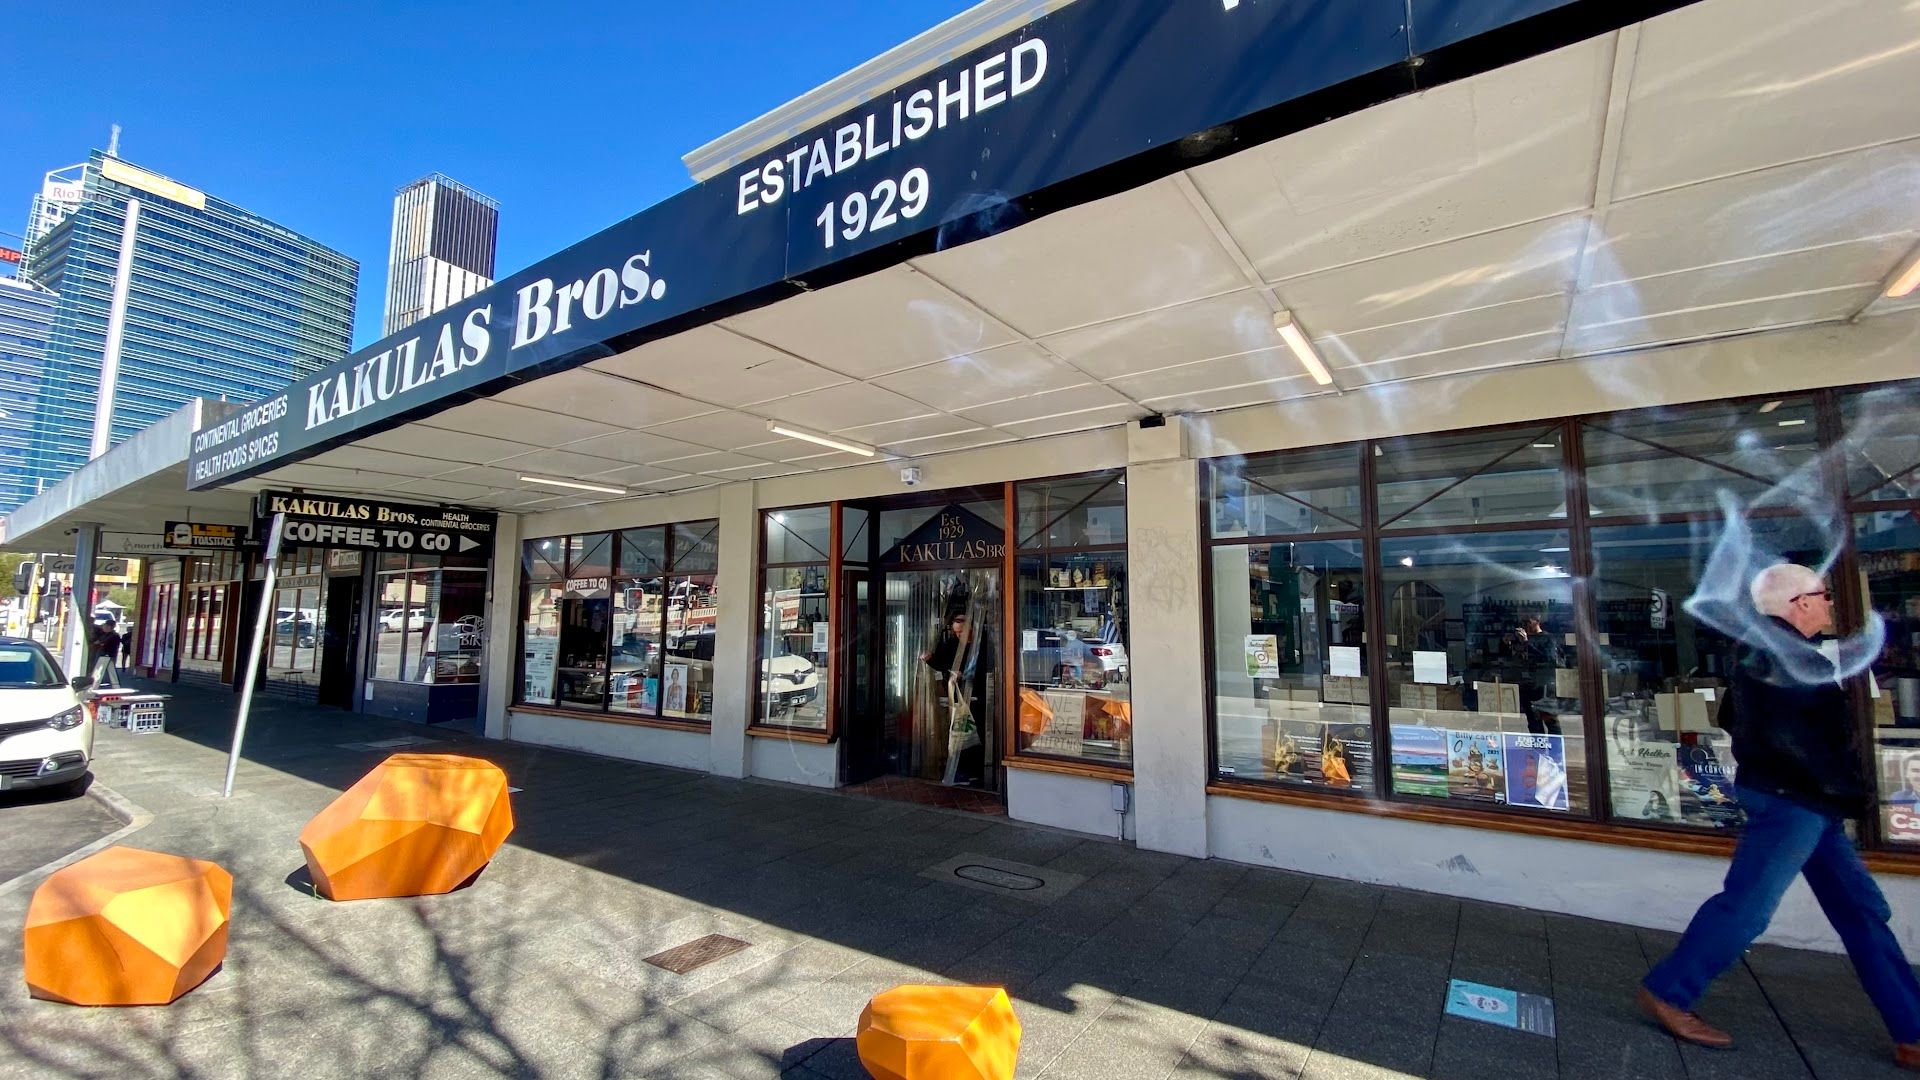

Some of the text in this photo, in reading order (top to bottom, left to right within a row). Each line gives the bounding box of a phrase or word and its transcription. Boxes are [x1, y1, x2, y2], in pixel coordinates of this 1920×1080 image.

[738, 38, 1048, 215] ESTABLISHED
[53, 187, 75, 199] Rio
[816, 167, 929, 249] 1929
[304, 250, 667, 431] KAKULAS Bros.
[195, 394, 288, 453] CONTINENTAL GROCERIES
[195, 431, 279, 481] HEALTH FOODS SPICES
[270, 496, 418, 525] KAKULAS Bros.
[442, 512, 470, 522] HEALTH
[420, 518, 490, 532] CONTINENTAL GROCERIES
[941, 513, 960, 527] Est
[283, 521, 451, 551] COFFEE TO GO
[939, 526, 964, 540] 1929
[134, 541, 164, 549] north
[566, 577, 608, 592] COFFEE TO GO
[1046, 694, 1073, 713] WE
[1041, 716, 1075, 735] ARE
[1514, 741, 1552, 749] FASHION
[1517, 735, 1536, 743] END
